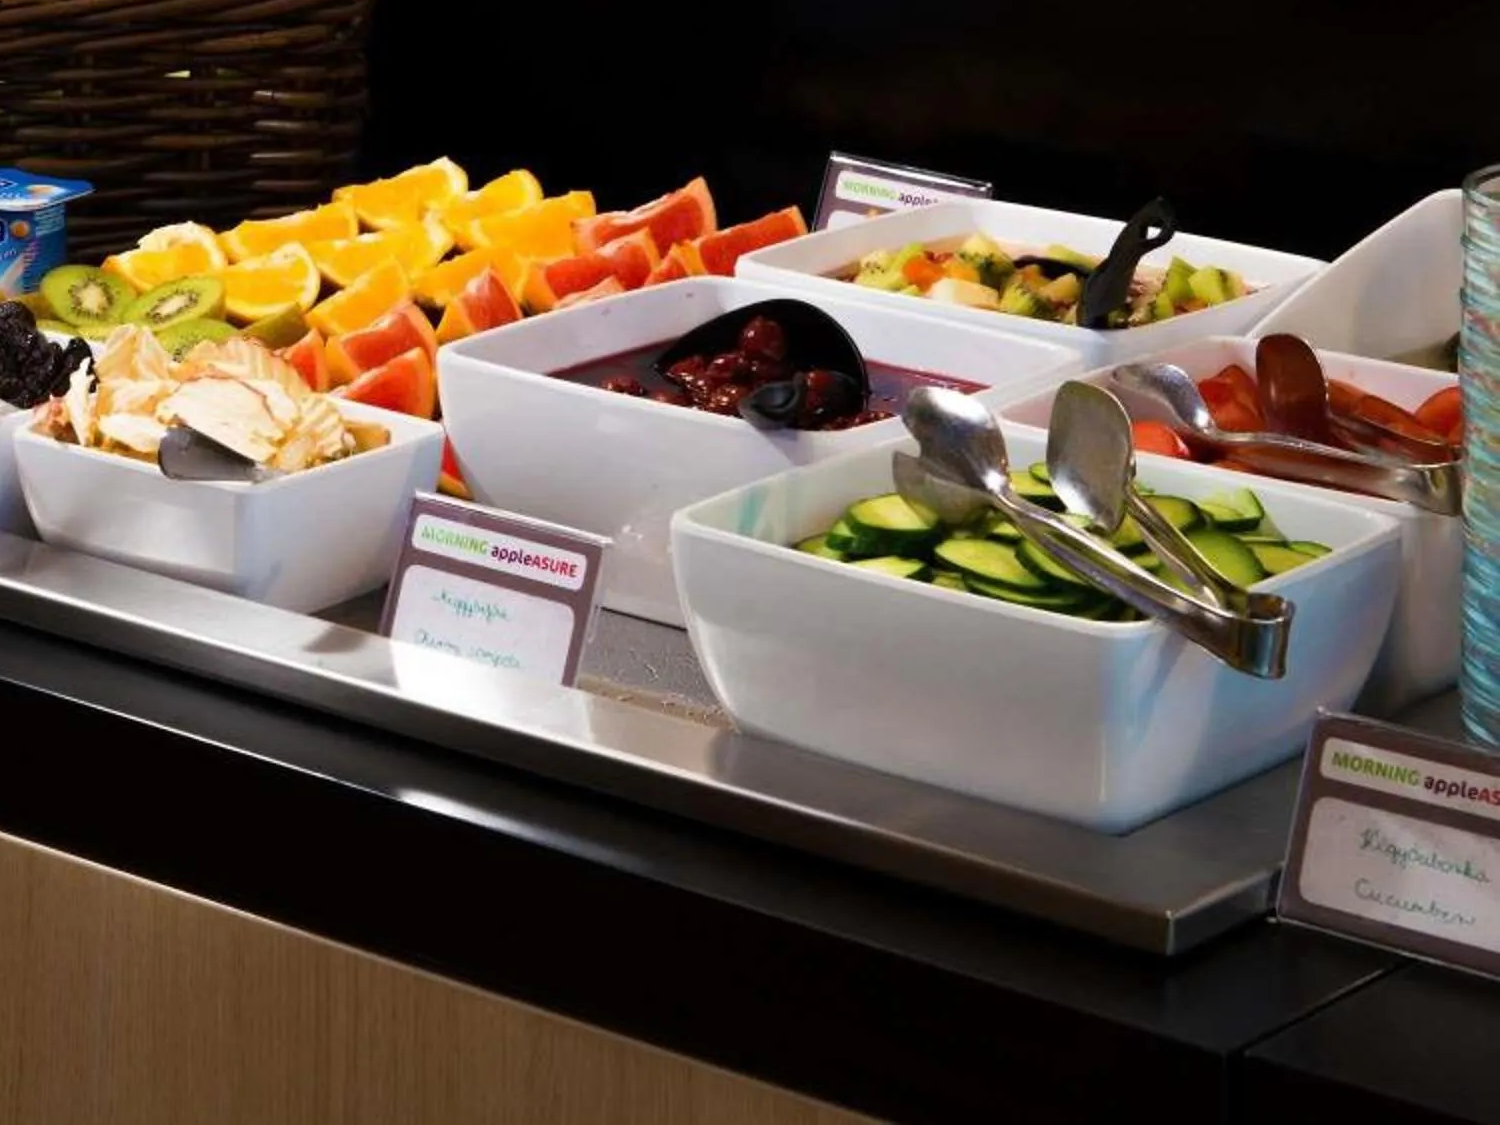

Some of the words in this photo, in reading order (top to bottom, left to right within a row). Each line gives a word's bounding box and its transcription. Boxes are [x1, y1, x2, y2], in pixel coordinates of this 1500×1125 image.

[420, 525, 488, 556] MORNING
[490, 544, 579, 578] appleASURE
[1331, 750, 1421, 786] MORNING
